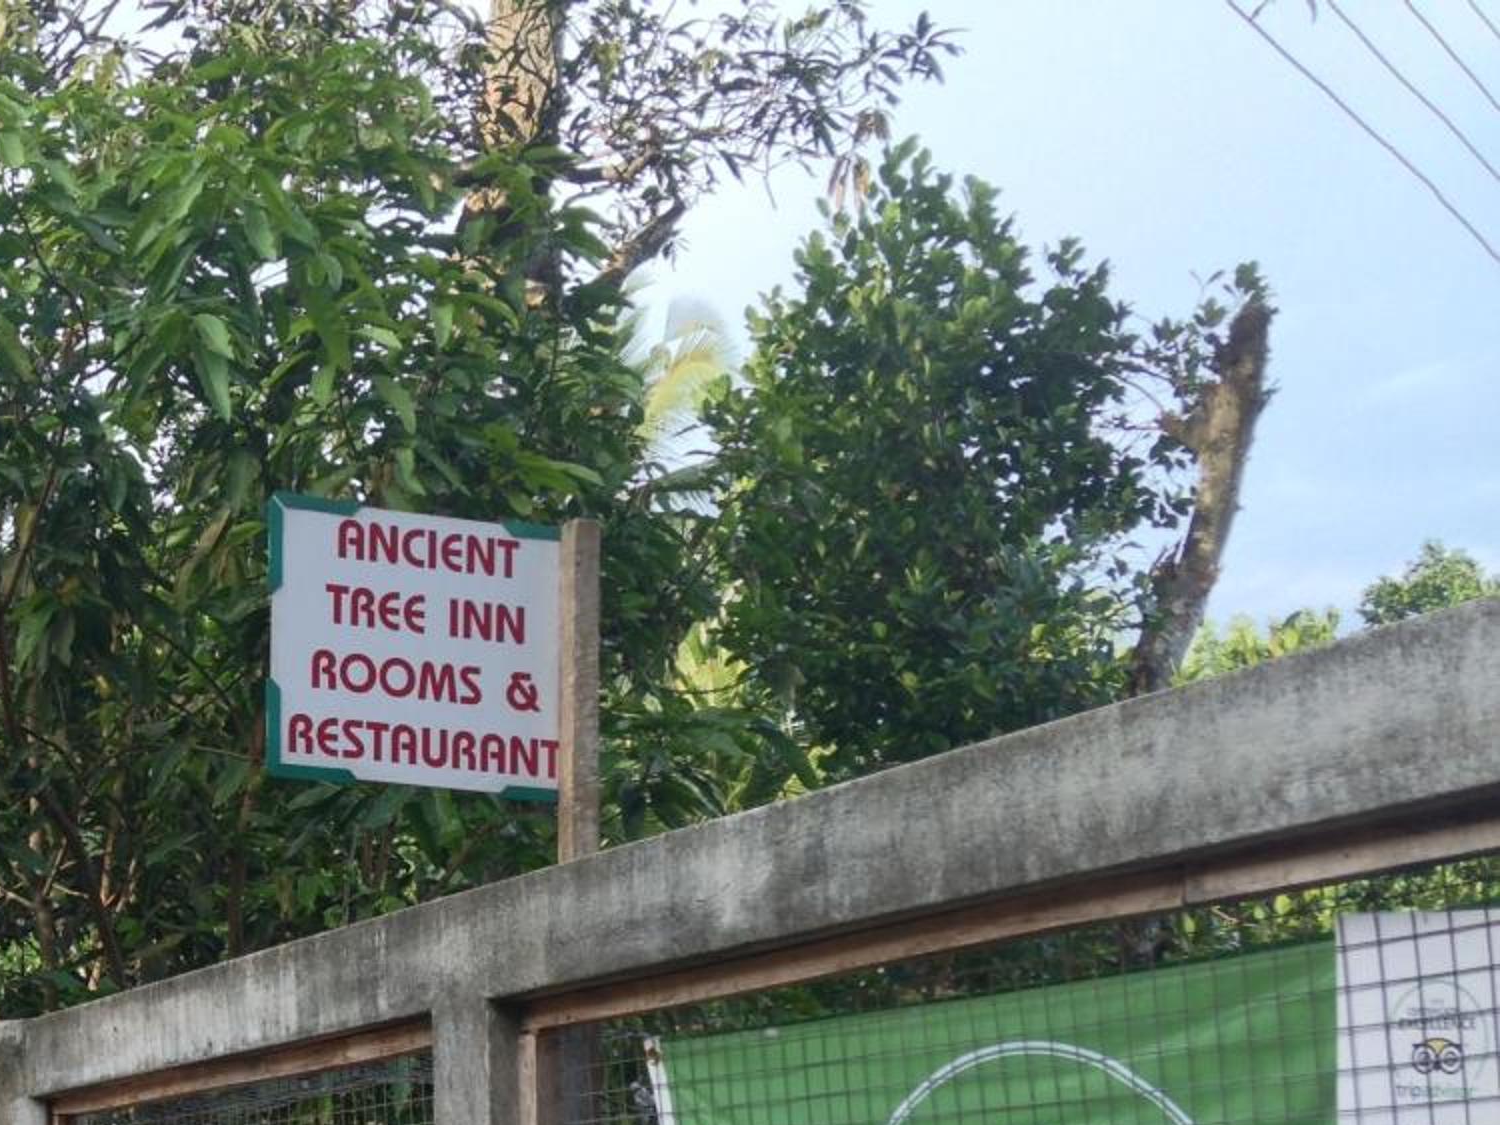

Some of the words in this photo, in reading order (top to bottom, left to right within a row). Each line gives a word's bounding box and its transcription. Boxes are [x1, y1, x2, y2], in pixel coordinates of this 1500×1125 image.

[337, 519, 520, 578] ANCIENT
[326, 583, 425, 634] TREE
[449, 598, 525, 644] INN
[311, 649, 482, 705] ROOMS
[506, 671, 540, 712] &
[288, 713, 560, 779] RESTAURANT
